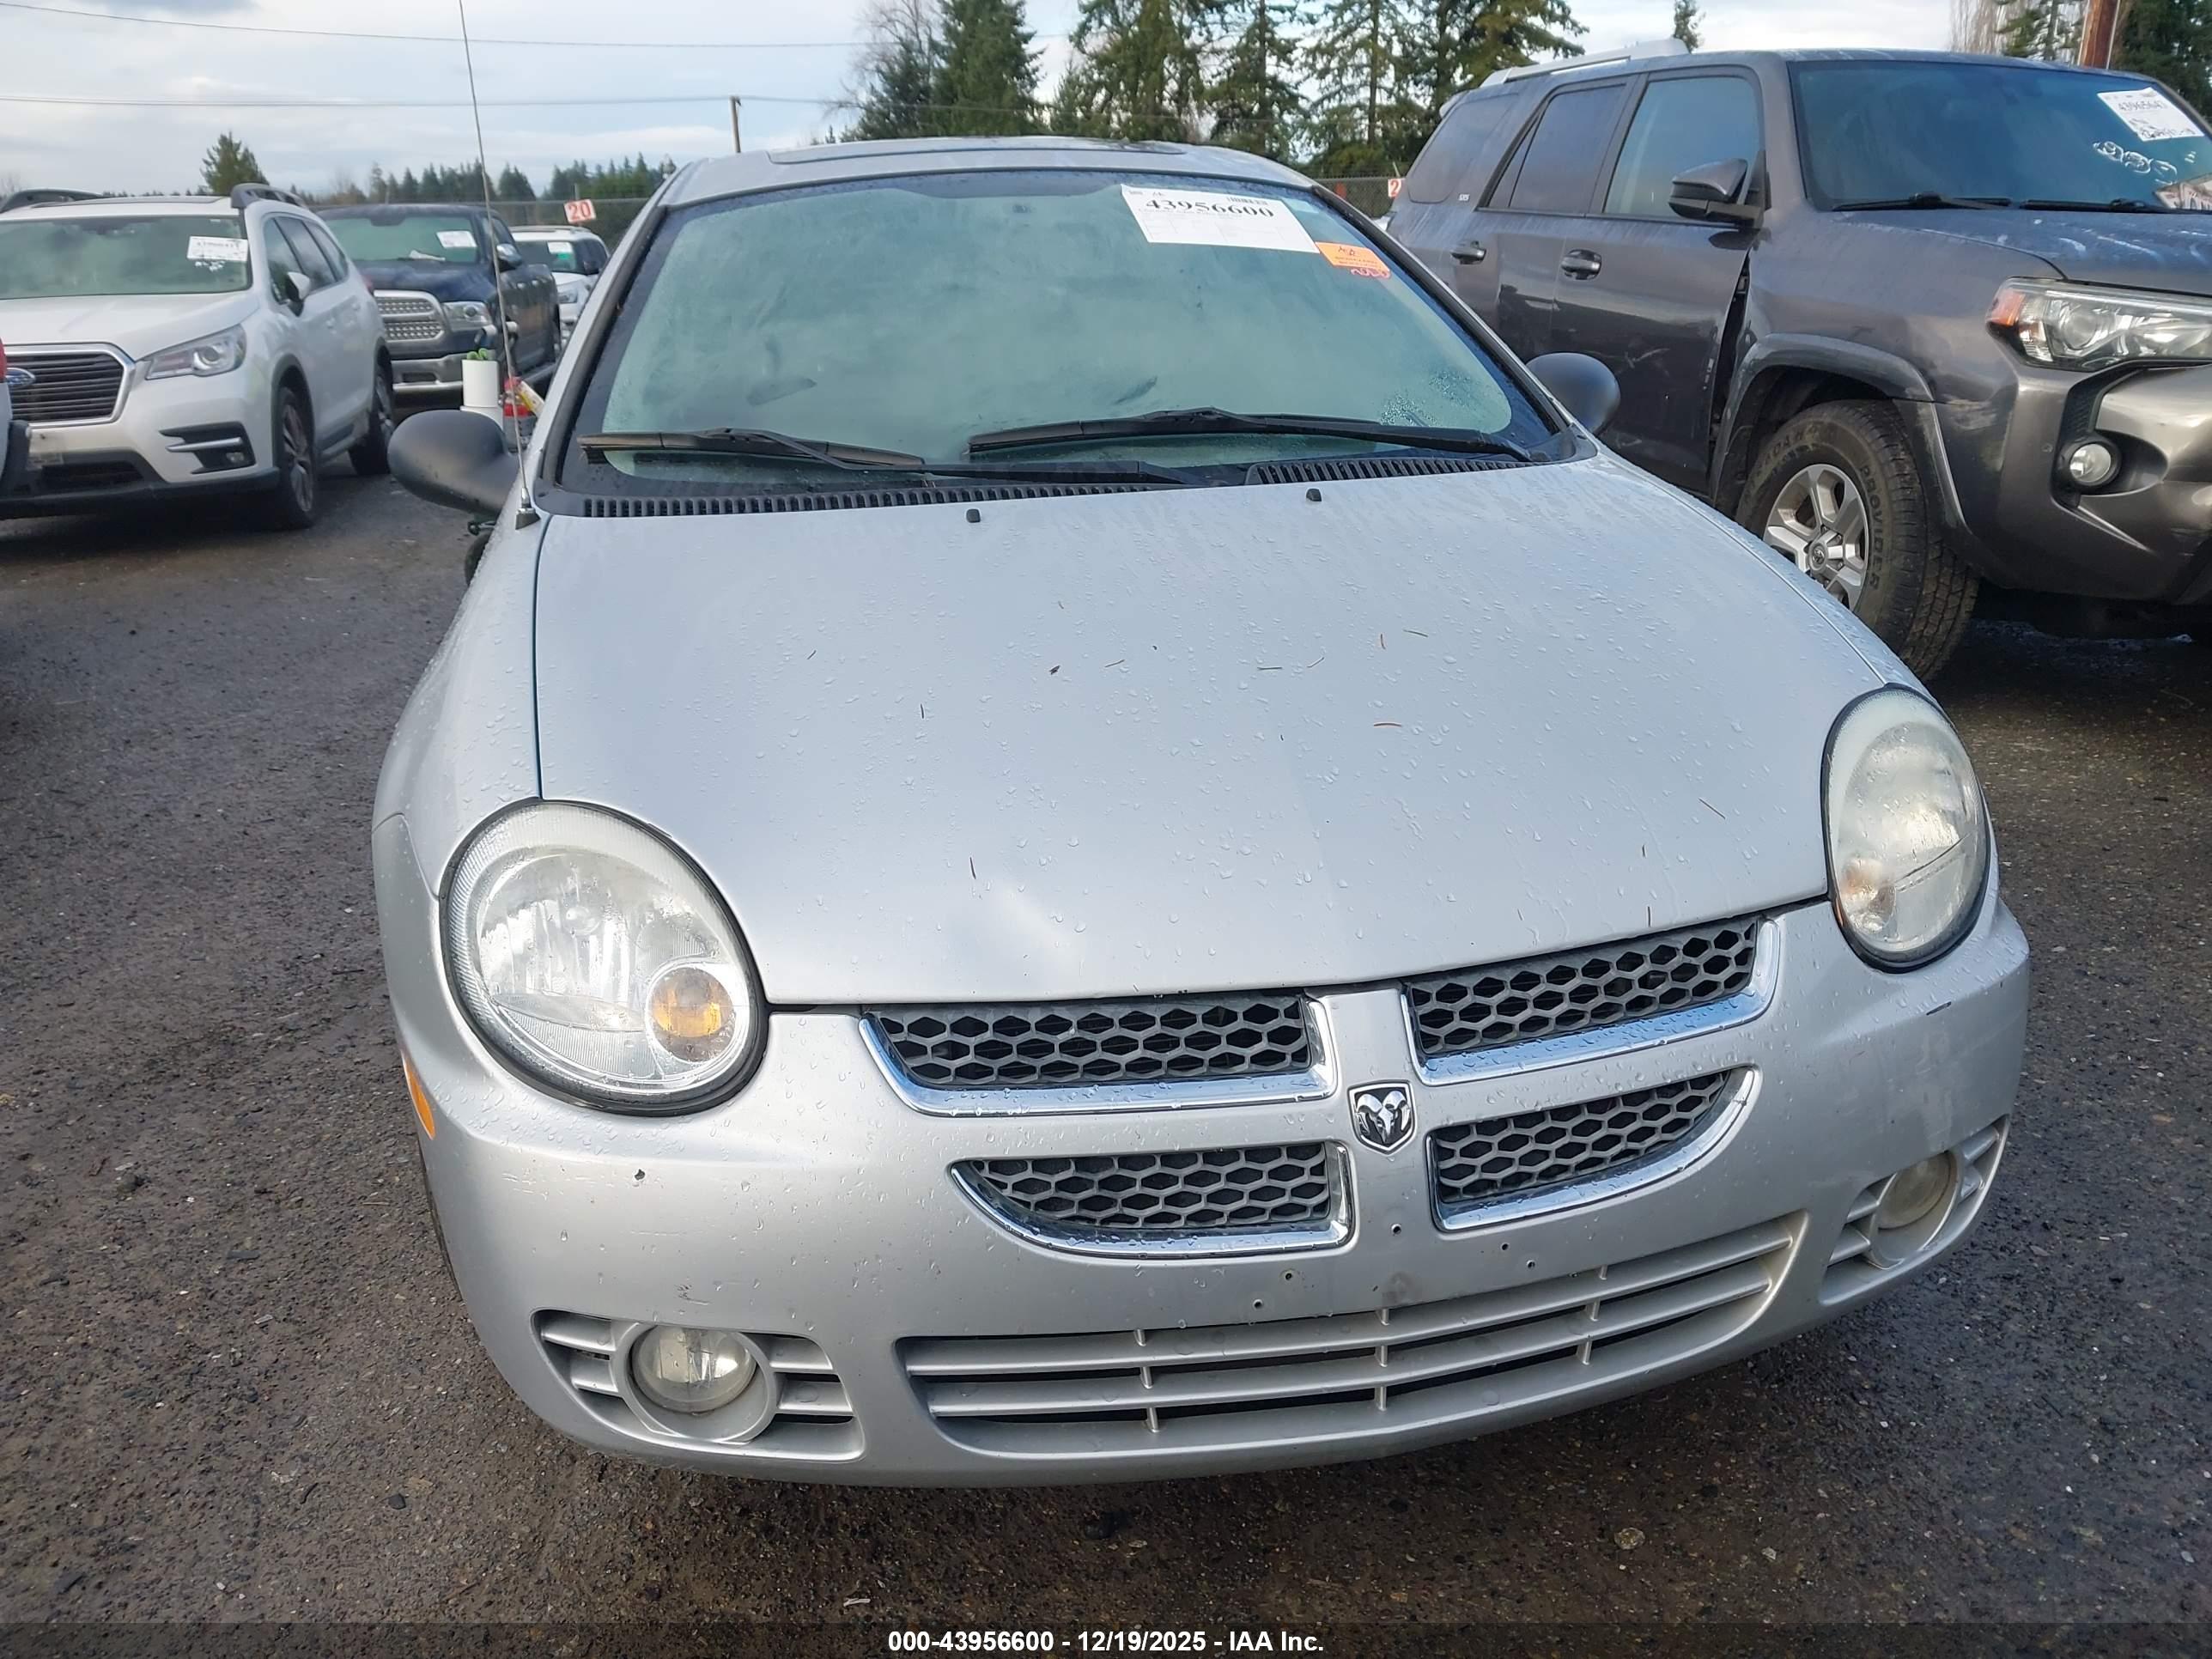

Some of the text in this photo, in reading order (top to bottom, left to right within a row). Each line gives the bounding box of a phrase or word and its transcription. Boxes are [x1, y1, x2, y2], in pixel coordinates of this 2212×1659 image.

[568, 201, 591, 220] 20
[1146, 199, 1274, 217] 43956600
[1861, 465, 1883, 590] PROVIDER
